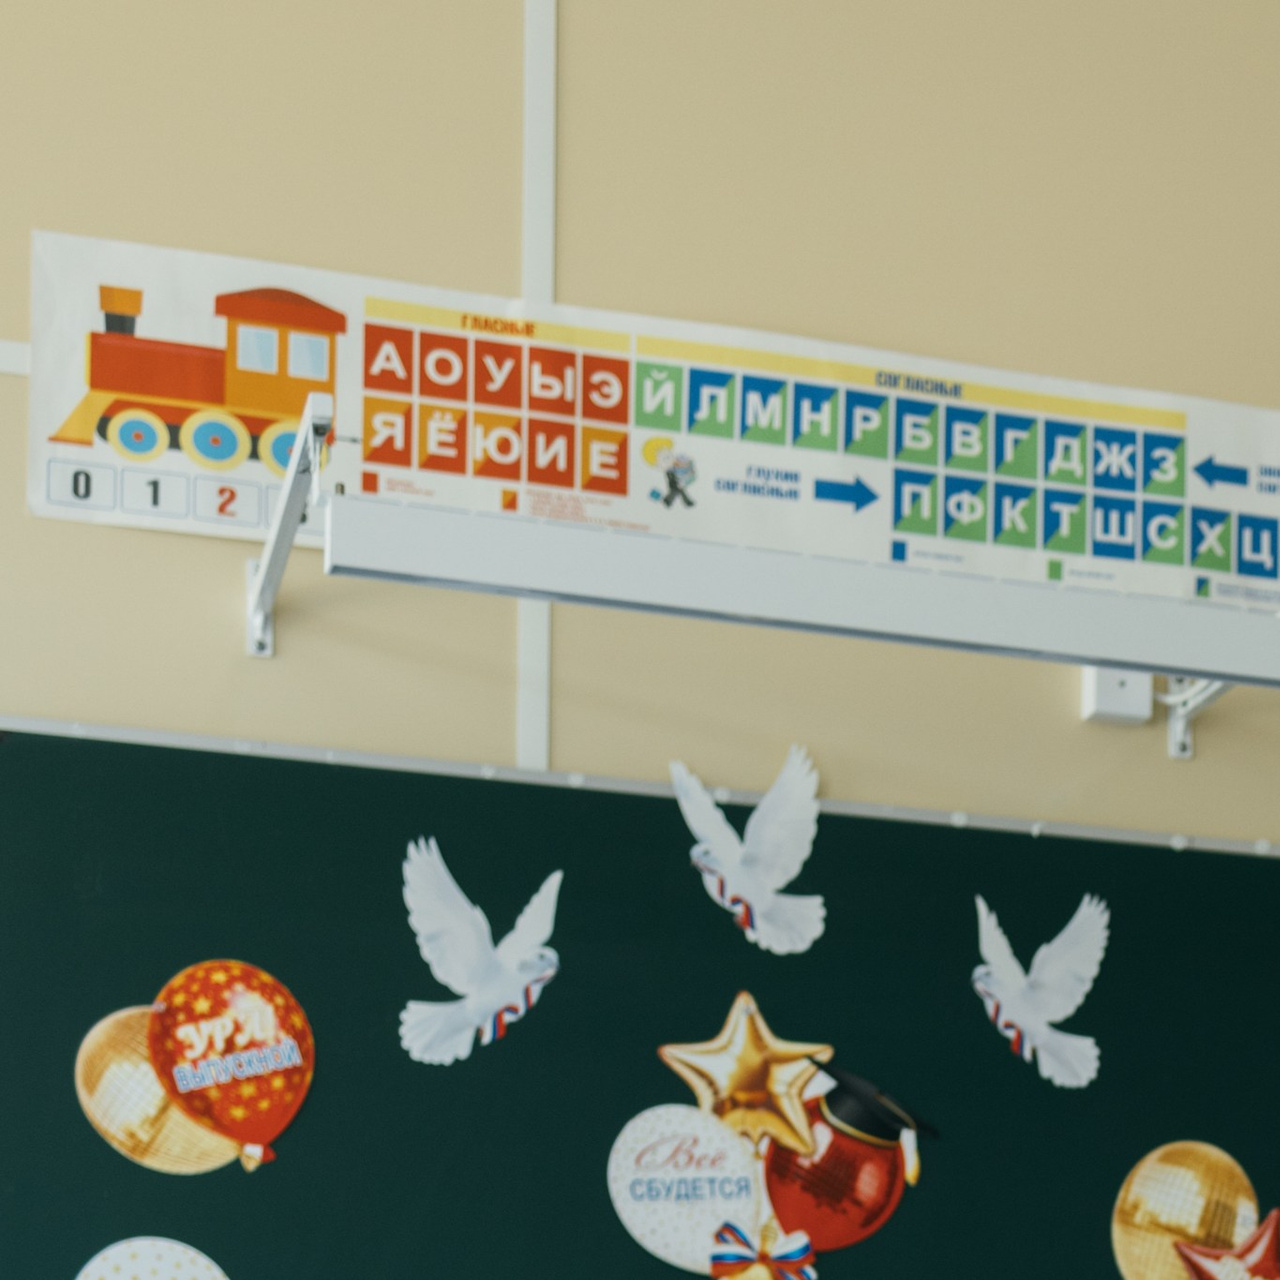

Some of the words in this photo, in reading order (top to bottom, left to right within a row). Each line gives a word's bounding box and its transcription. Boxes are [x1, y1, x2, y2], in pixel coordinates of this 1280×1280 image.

[369, 340, 407, 380] А
[424, 348, 463, 386] О
[482, 354, 515, 392] У
[530, 361, 574, 402] Ы
[588, 370, 623, 408] Э
[370, 412, 405, 451] Я
[427, 410, 458, 459] Ё
[475, 423, 522, 465] Ю
[535, 432, 567, 472] И
[589, 441, 619, 479] Е
[643, 369, 675, 416] Й
[694, 385, 728, 423] Л
[746, 391, 782, 430] М
[800, 397, 831, 437] Н
[853, 406, 881, 441] Р
[902, 413, 932, 450] Б
[952, 420, 982, 457] В
[1003, 428, 1031, 463] Г
[1048, 435, 1083, 479] Д
[1095, 440, 1135, 479] Ж
[1150, 446, 1178, 483] З
[147, 479, 160, 507] 1
[216, 486, 238, 517] 2
[901, 482, 932, 519] П
[946, 490, 984, 525] Ф
[1002, 497, 1029, 533] К
[1050, 502, 1080, 538] Т
[1094, 508, 1134, 546] Ш
[1146, 514, 1178, 549] С
[1196, 519, 1226, 556] Х
[1242, 527, 1273, 571] Ц
[173, 1035, 303, 1094] ВЫПУСКНОЙ
[629, 1176, 751, 1204] СБУДЕТСЯ
